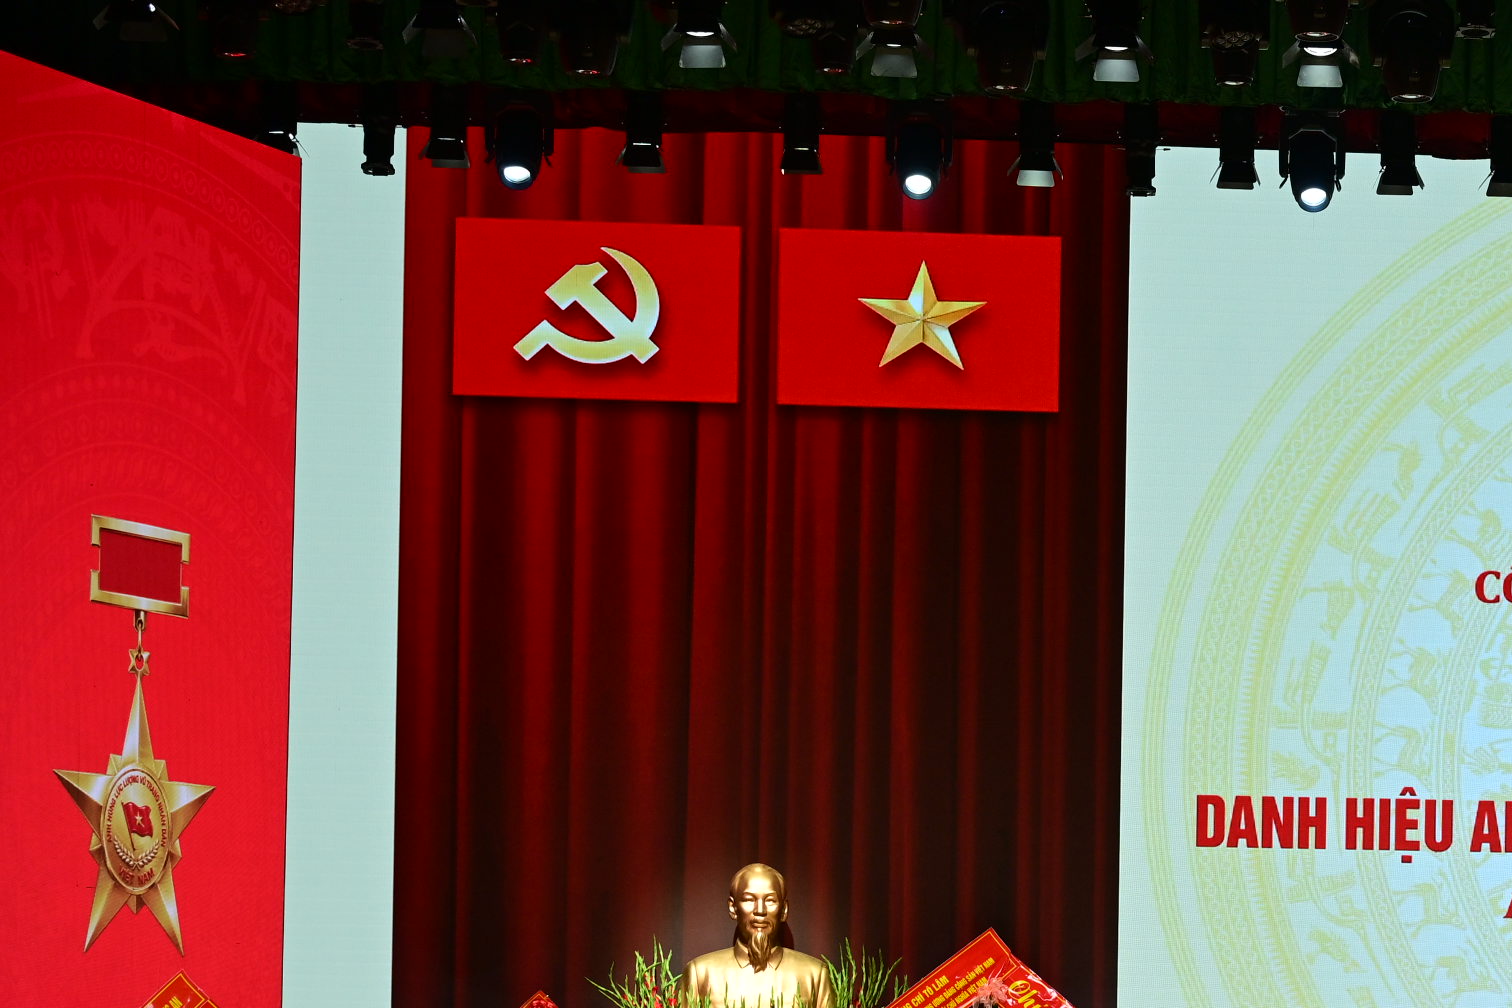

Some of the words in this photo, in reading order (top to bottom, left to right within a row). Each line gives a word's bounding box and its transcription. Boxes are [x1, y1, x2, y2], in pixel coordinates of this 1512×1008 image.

[1197, 795, 1327, 849] DANH
[1346, 787, 1453, 862] HIỆU
[138, 868, 155, 885] NAM
[911, 993, 925, 1007] CHÍ
[922, 985, 935, 998] TÔ
[931, 975, 949, 991] LÂM
